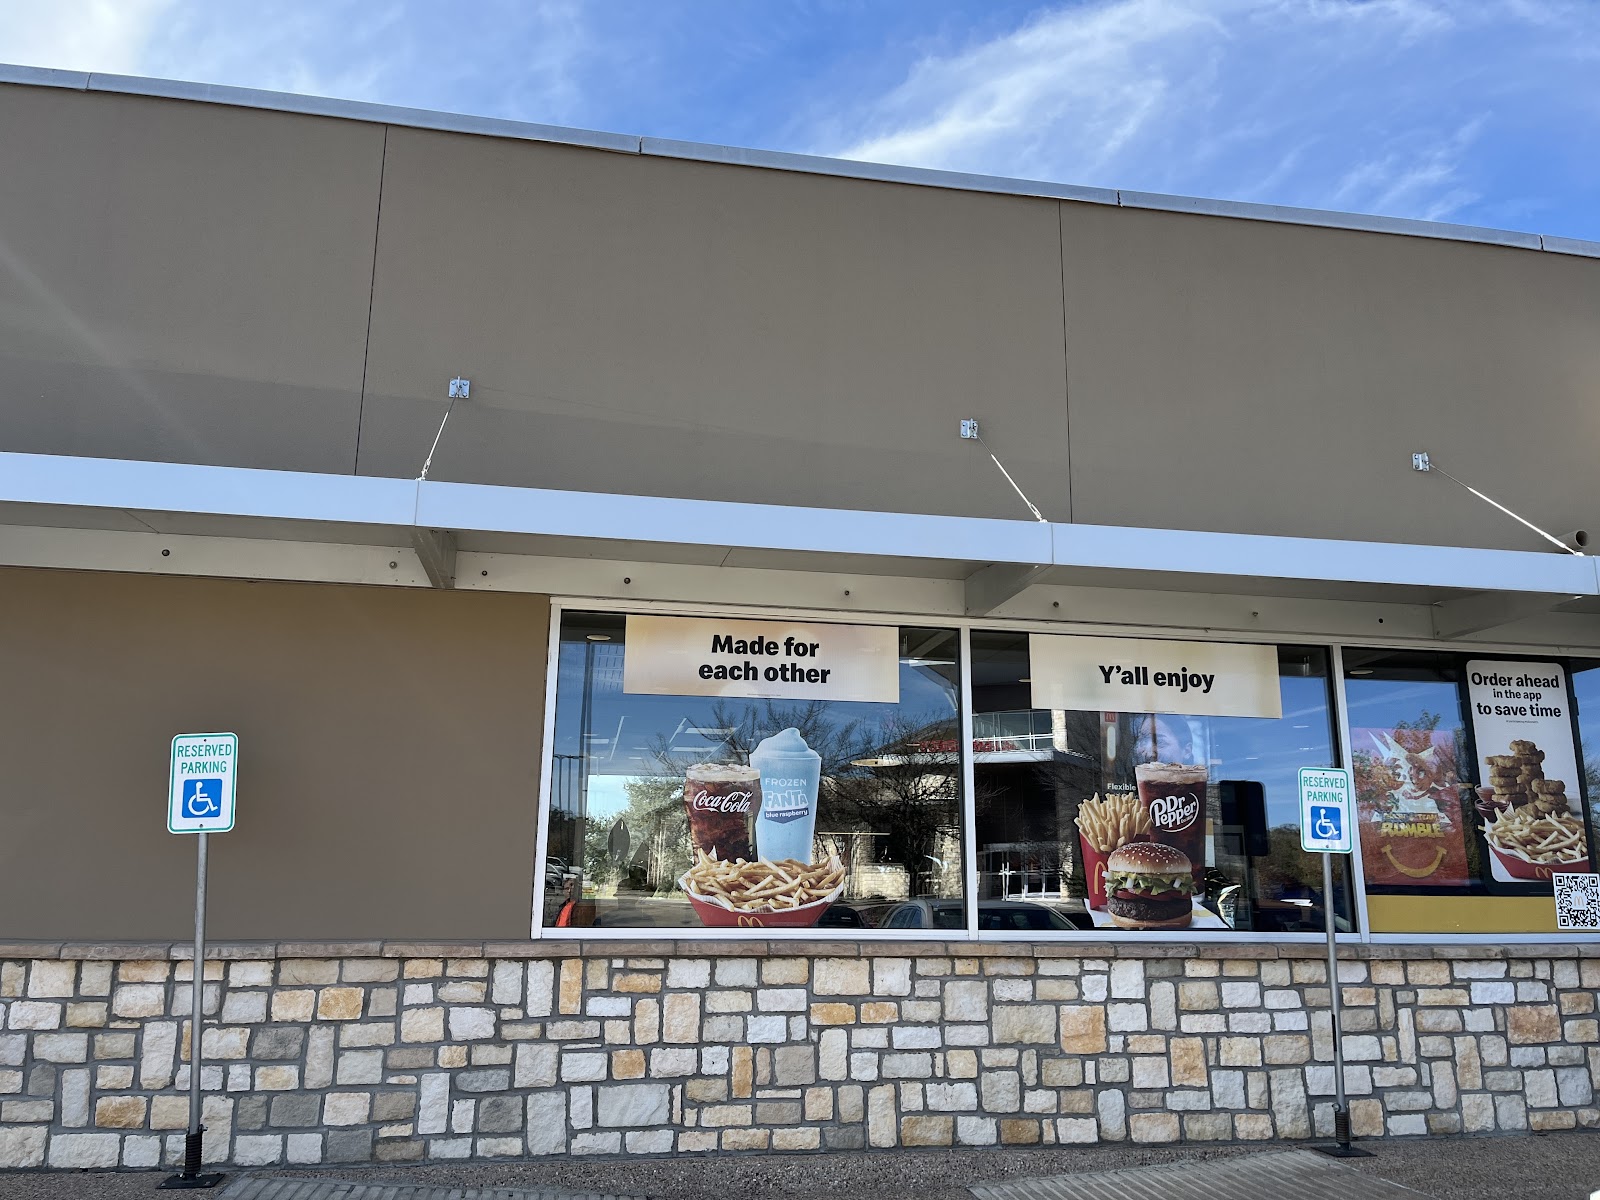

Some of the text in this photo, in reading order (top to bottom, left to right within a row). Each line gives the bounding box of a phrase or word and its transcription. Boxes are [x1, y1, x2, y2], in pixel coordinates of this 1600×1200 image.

[711, 634, 820, 657] Made for
[698, 661, 831, 684] each other
[1098, 665, 1215, 694] Y'all enjoy
[1471, 672, 1560, 689] Order ahead
[1492, 688, 1542, 702] in the app
[1476, 702, 1562, 718] to save time
[177, 743, 232, 758] RESERVED
[180, 761, 227, 775] PARKING
[765, 777, 807, 787] FROZEN
[1107, 783, 1137, 791] Flexible
[1303, 776, 1346, 789] RESERVED
[763, 789, 809, 811] FANTA
[1165, 795, 1185, 813] Dr
[1307, 790, 1343, 803] PARKING
[779, 810, 808, 819] raspberry
[1149, 798, 1197, 829] Pepper
[1380, 821, 1446, 838] RUMBLE
